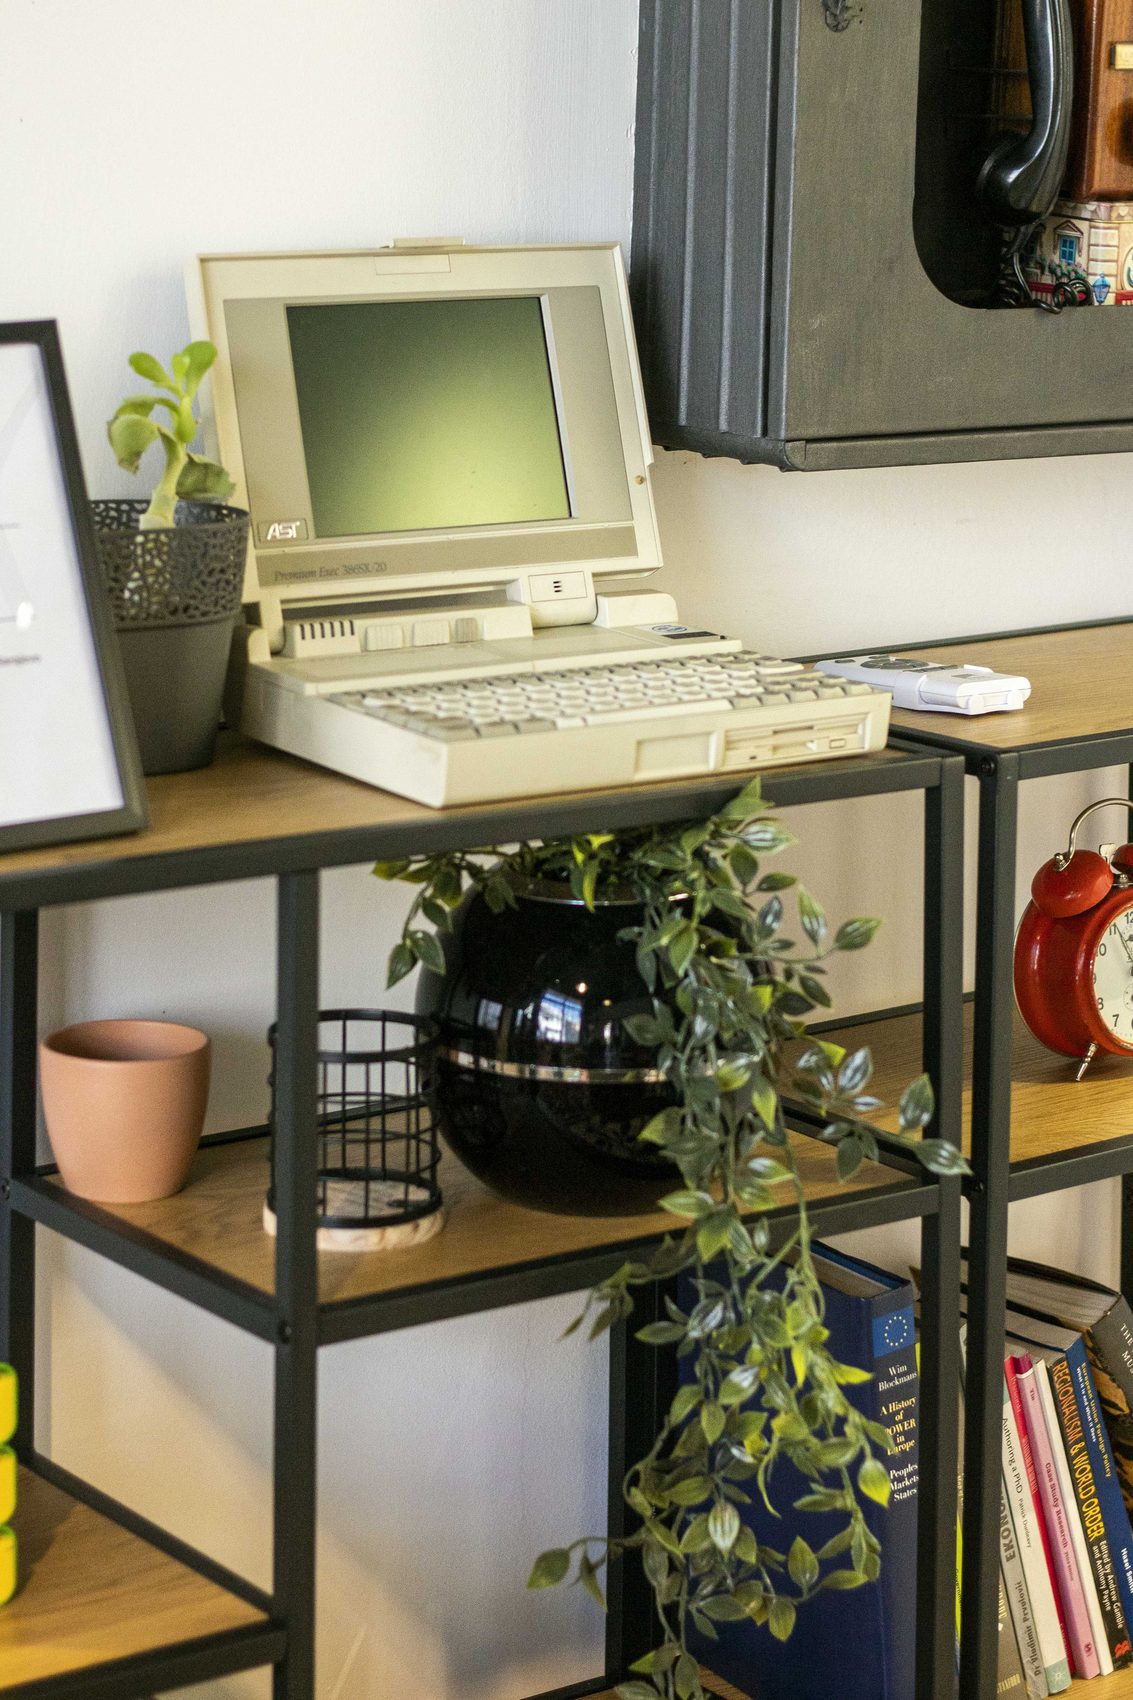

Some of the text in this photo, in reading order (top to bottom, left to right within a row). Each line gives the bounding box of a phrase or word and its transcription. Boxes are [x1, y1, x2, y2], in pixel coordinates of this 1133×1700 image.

[267, 521, 300, 540] AST
[1112, 1013, 1120, 1027] 7
[889, 1365, 907, 1376] Wim
[878, 1372, 917, 1391] Blockmans
[880, 1397, 917, 1416] A History
[895, 1410, 904, 1421] of
[1081, 1362, 1112, 1478] European Union Foreign Policy
[896, 1434, 905, 1443] in
[1001, 1418, 1016, 1466] Authoring
[1013, 1472, 1023, 1494] PhD
[1052, 1360, 1105, 1541] REGIONALISM & WORLD ORDER
[890, 1463, 918, 1479] Peoples
[894, 1487, 917, 1501] States
[1045, 1462, 1053, 1483] Case
[1049, 1483, 1059, 1508] Study
[1056, 1509, 1069, 1548] Research
[1121, 1547, 1131, 1570] Hazel
[1092, 1545, 1111, 1611] and Anthony Payne
[1100, 1540, 1125, 1629] Edited by Andrew Gamble
[1025, 1625, 1038, 1664] Vladimir
[1033, 1663, 1041, 1677] Dr
